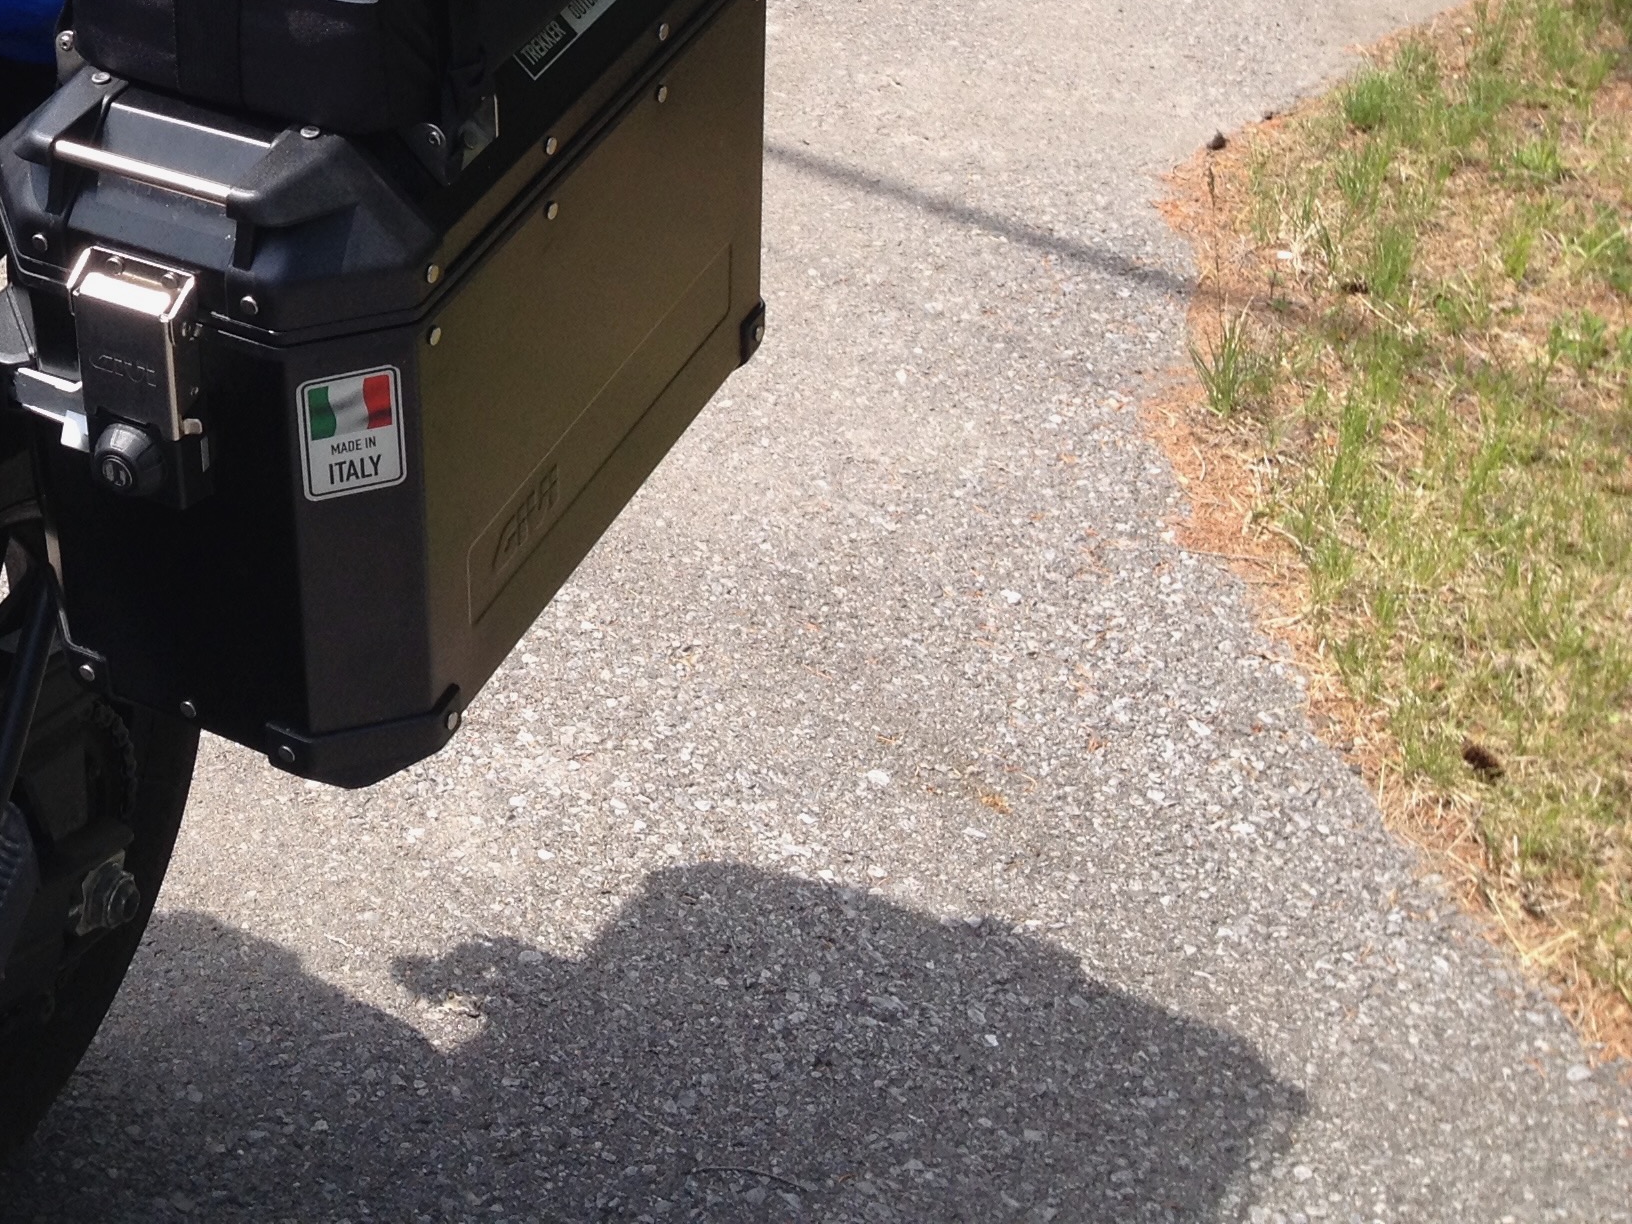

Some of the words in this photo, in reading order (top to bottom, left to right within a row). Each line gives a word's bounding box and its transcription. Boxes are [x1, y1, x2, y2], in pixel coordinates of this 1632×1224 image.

[520, 20, 567, 66] TREKKER
[330, 437, 362, 455] MADE
[365, 435, 377, 449] IN
[328, 454, 382, 485] ITALY
